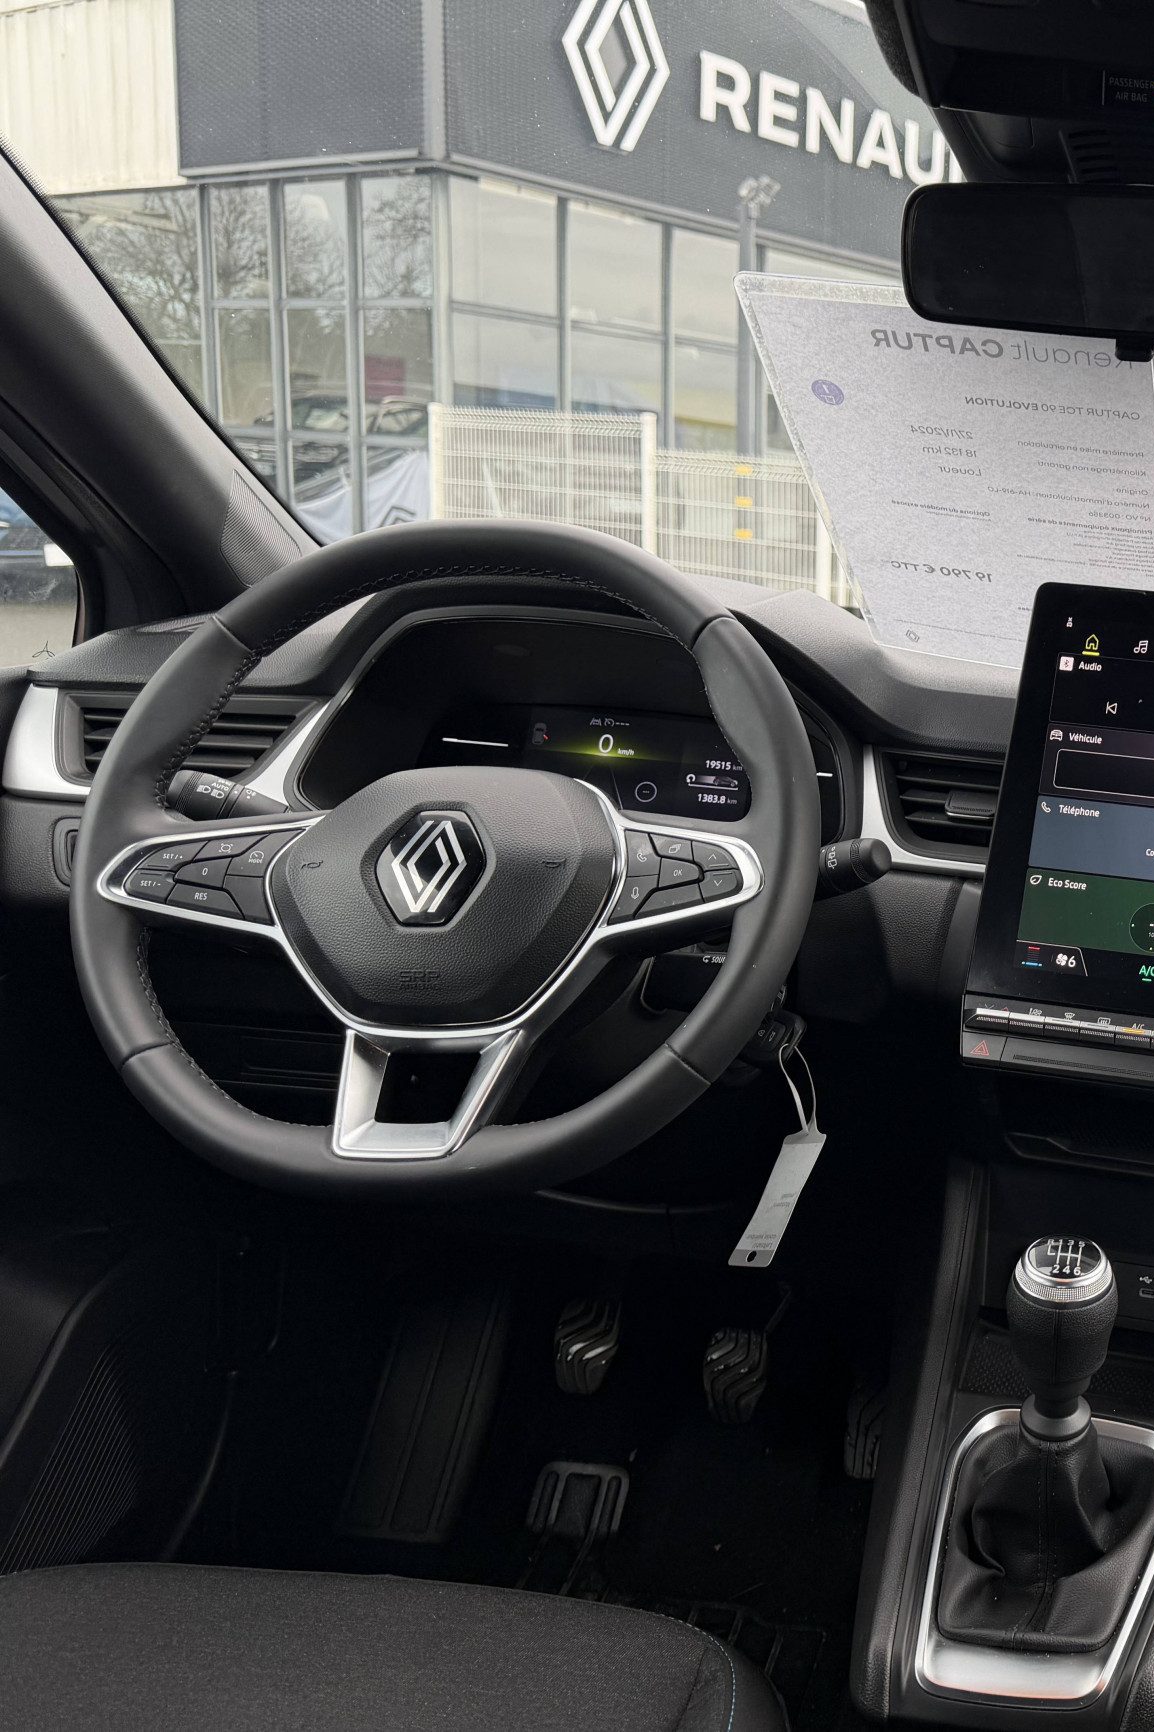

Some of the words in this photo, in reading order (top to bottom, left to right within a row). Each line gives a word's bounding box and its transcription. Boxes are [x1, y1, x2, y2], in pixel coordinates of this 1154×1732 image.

[1109, 77, 1154, 89] PASSENGER
[1115, 91, 1128, 100] AIR
[1131, 92, 1148, 103] BAG
[1078, 661, 1102, 672] Audio
[598, 733, 614, 754] 0
[1068, 731, 1103, 745] Véhicule
[617, 748, 635, 757] km/h
[705, 760, 732, 771] 19515
[733, 764, 743, 772] km
[212, 782, 230, 792] AUTO
[697, 793, 726, 805] 1383.8
[1058, 804, 1100, 819] Téléphone
[674, 869, 683, 877] OK
[1048, 877, 1063, 888] Eco
[1064, 879, 1087, 891] Score
[194, 892, 208, 901] RES
[1067, 955, 1076, 968] 6
[1131, 1023, 1145, 1031] A/C
[1052, 1264, 1060, 1273] 2
[1063, 1265, 1071, 1274] 4
[1074, 1267, 1081, 1276] 6
